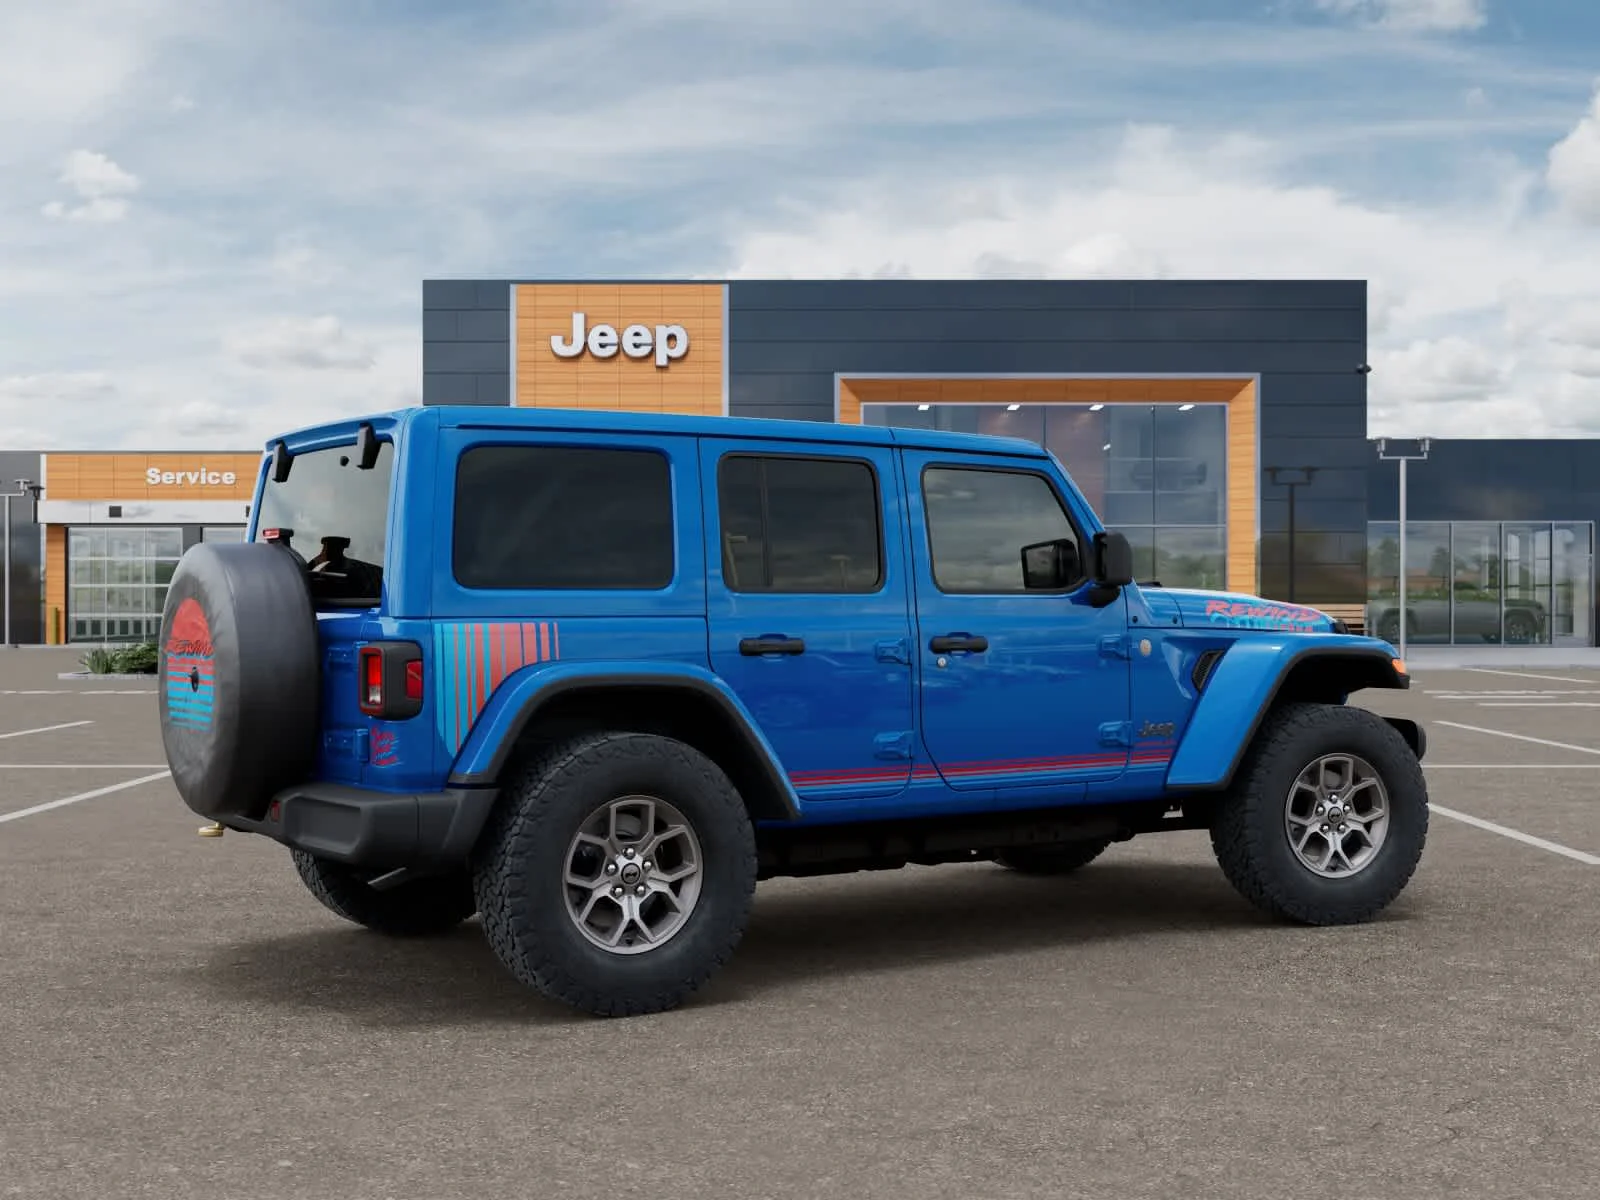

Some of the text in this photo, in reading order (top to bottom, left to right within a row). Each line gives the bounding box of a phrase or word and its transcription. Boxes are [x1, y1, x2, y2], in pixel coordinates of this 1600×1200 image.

[550, 311, 689, 367] Jeep
[146, 466, 236, 485] Service
[1137, 720, 1174, 738] Jeep
